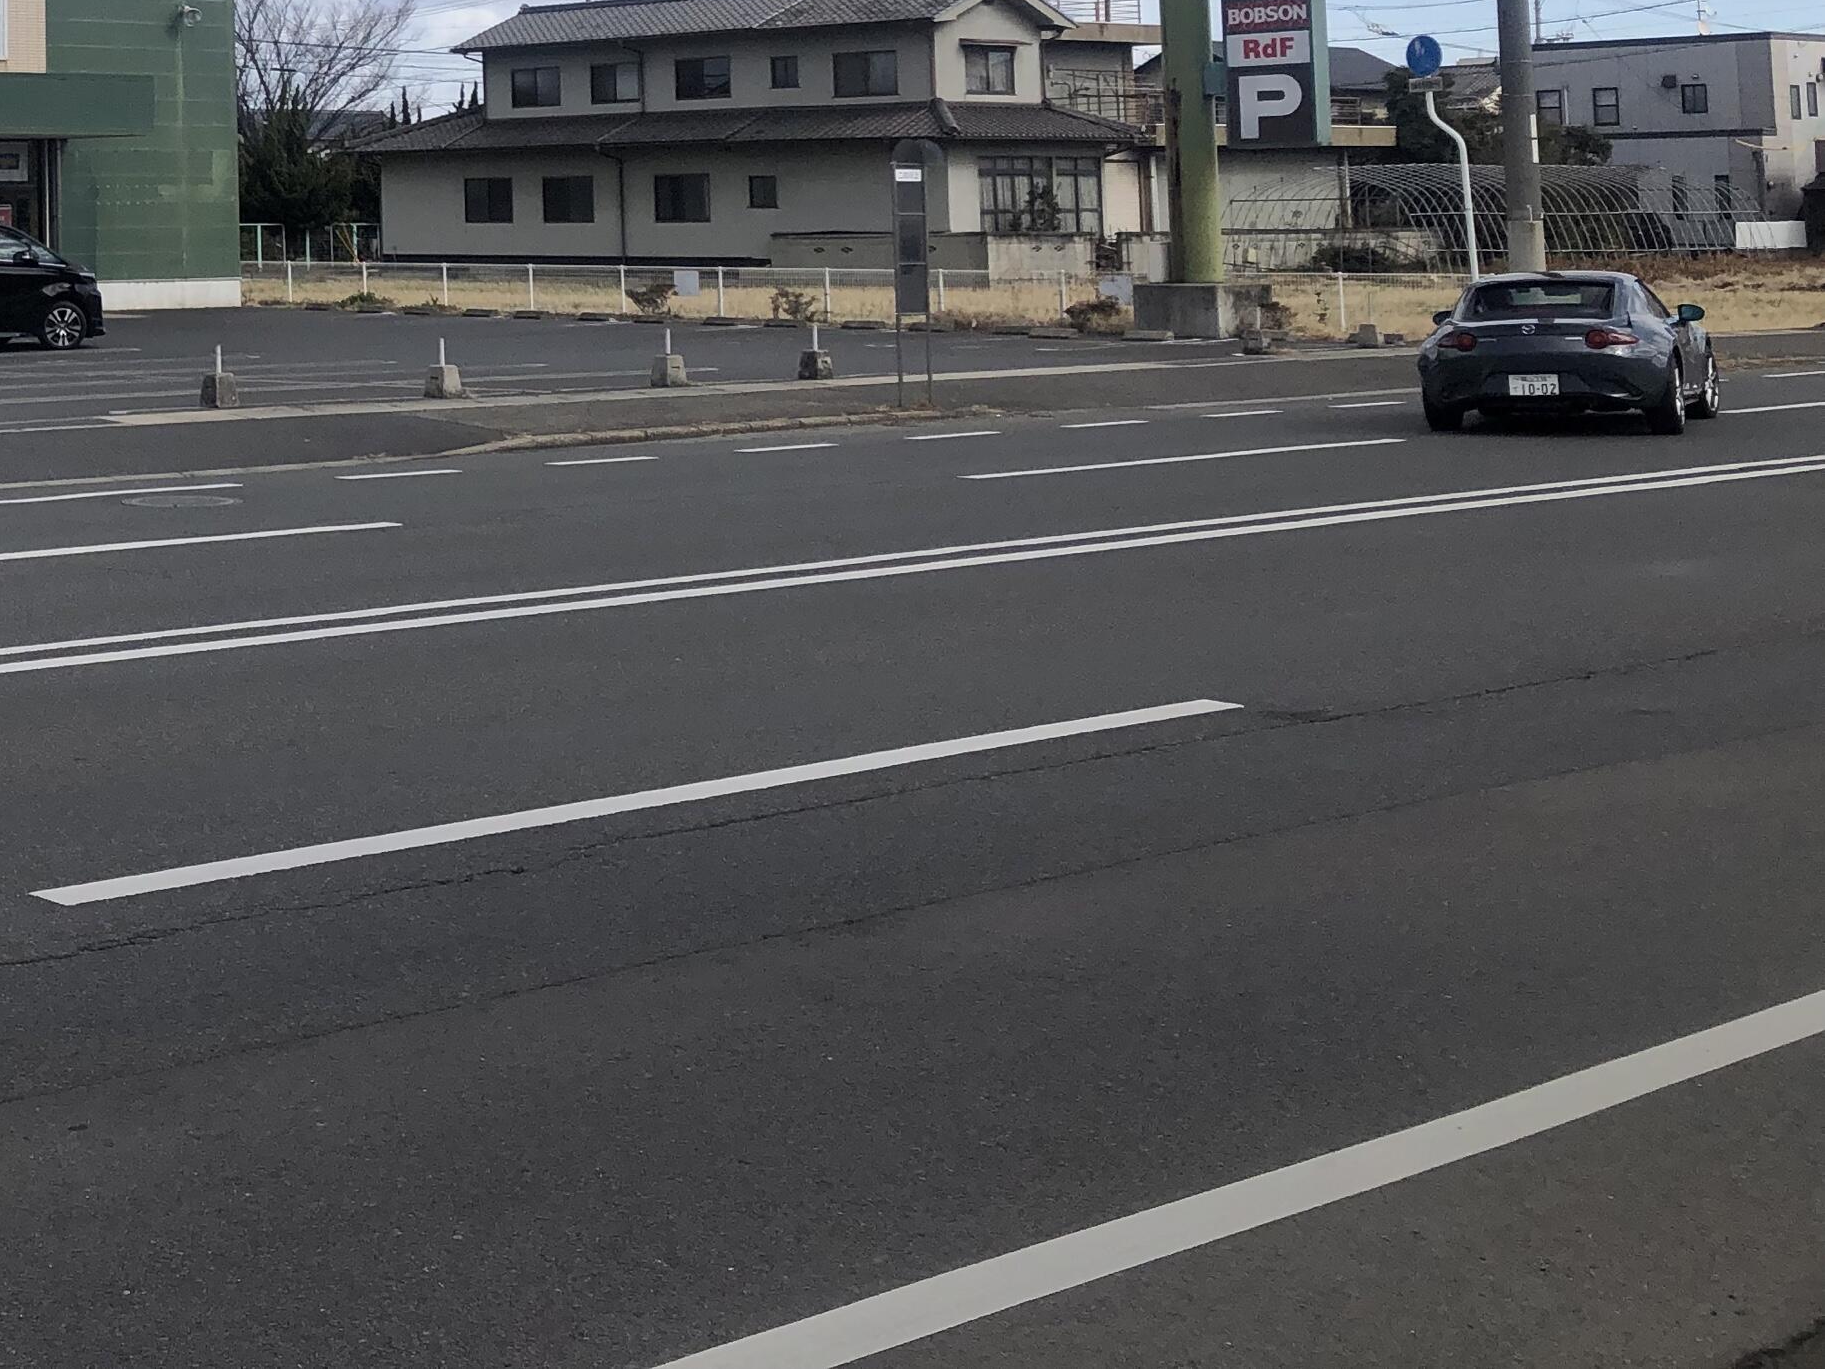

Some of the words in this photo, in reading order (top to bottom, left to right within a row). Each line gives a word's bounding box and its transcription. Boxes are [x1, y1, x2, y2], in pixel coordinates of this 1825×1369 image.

[1227, 4, 1307, 26] BOBSON
[1243, 37, 1295, 59] RdF
[1238, 73, 1303, 141] P
